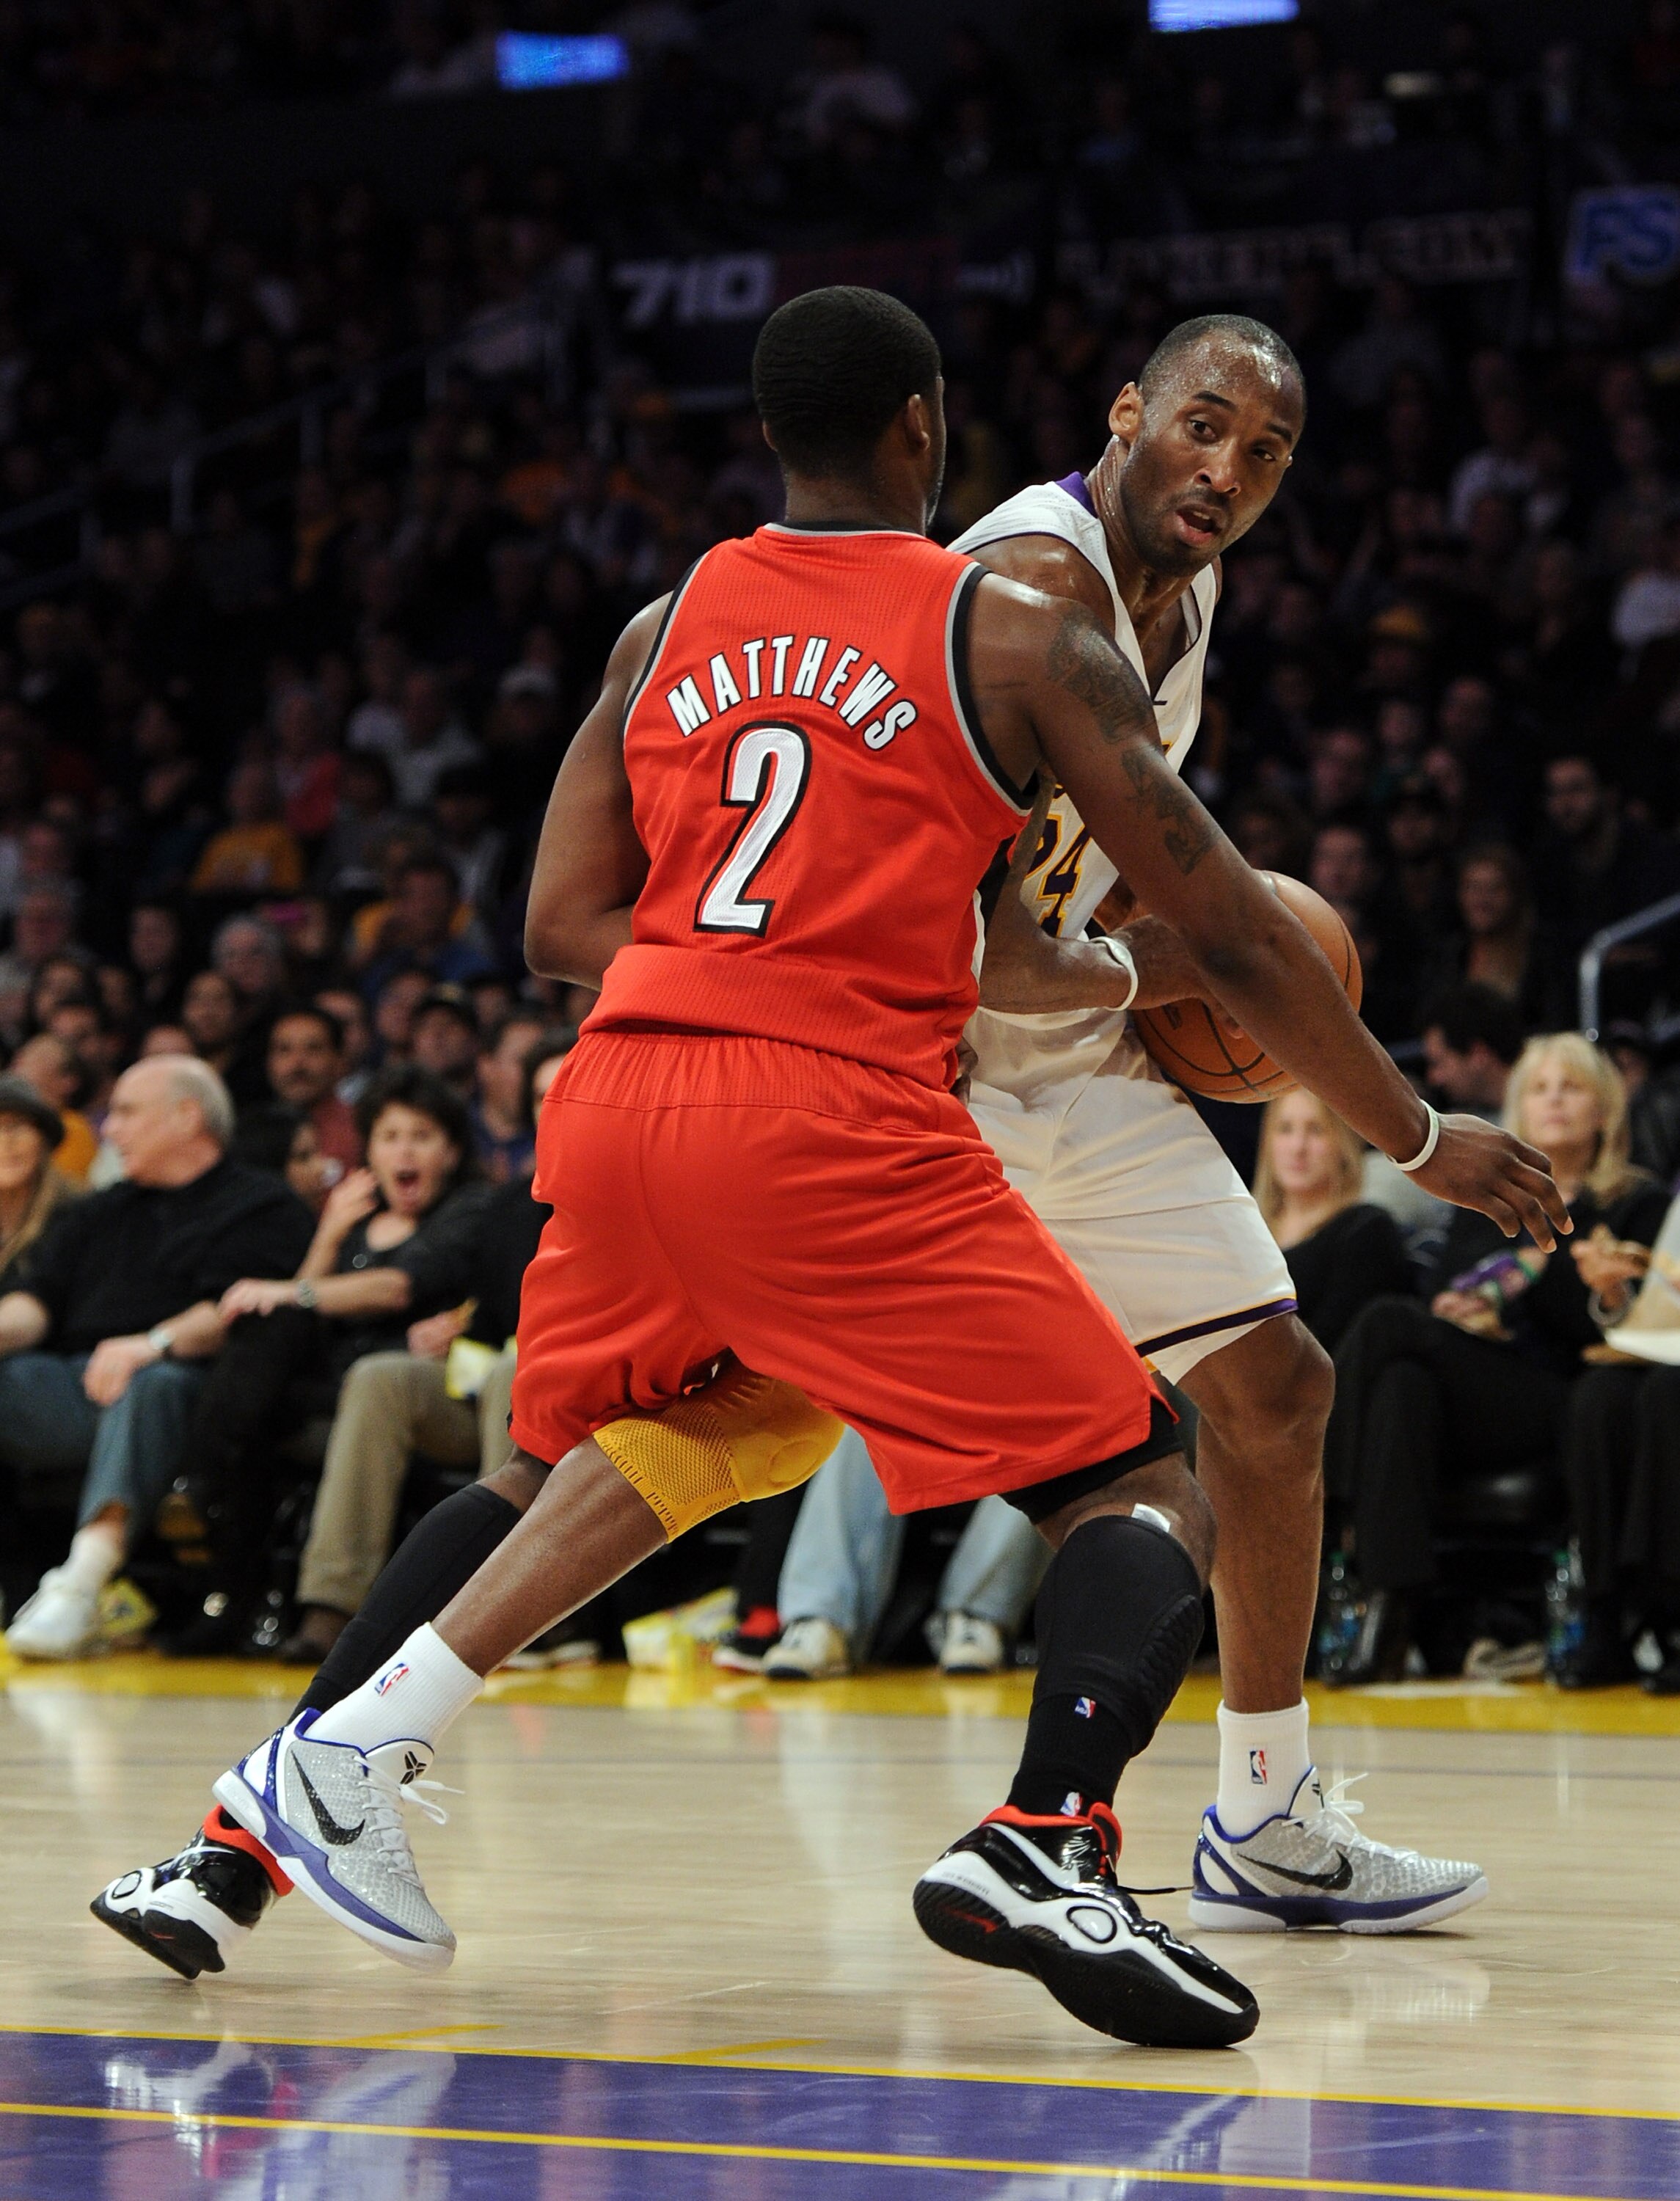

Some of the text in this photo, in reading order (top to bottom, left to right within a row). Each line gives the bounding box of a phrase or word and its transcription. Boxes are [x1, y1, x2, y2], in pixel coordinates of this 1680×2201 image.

[614, 253, 774, 328] 710
[666, 635, 917, 750] MATTHEWS
[693, 720, 812, 938] 2
